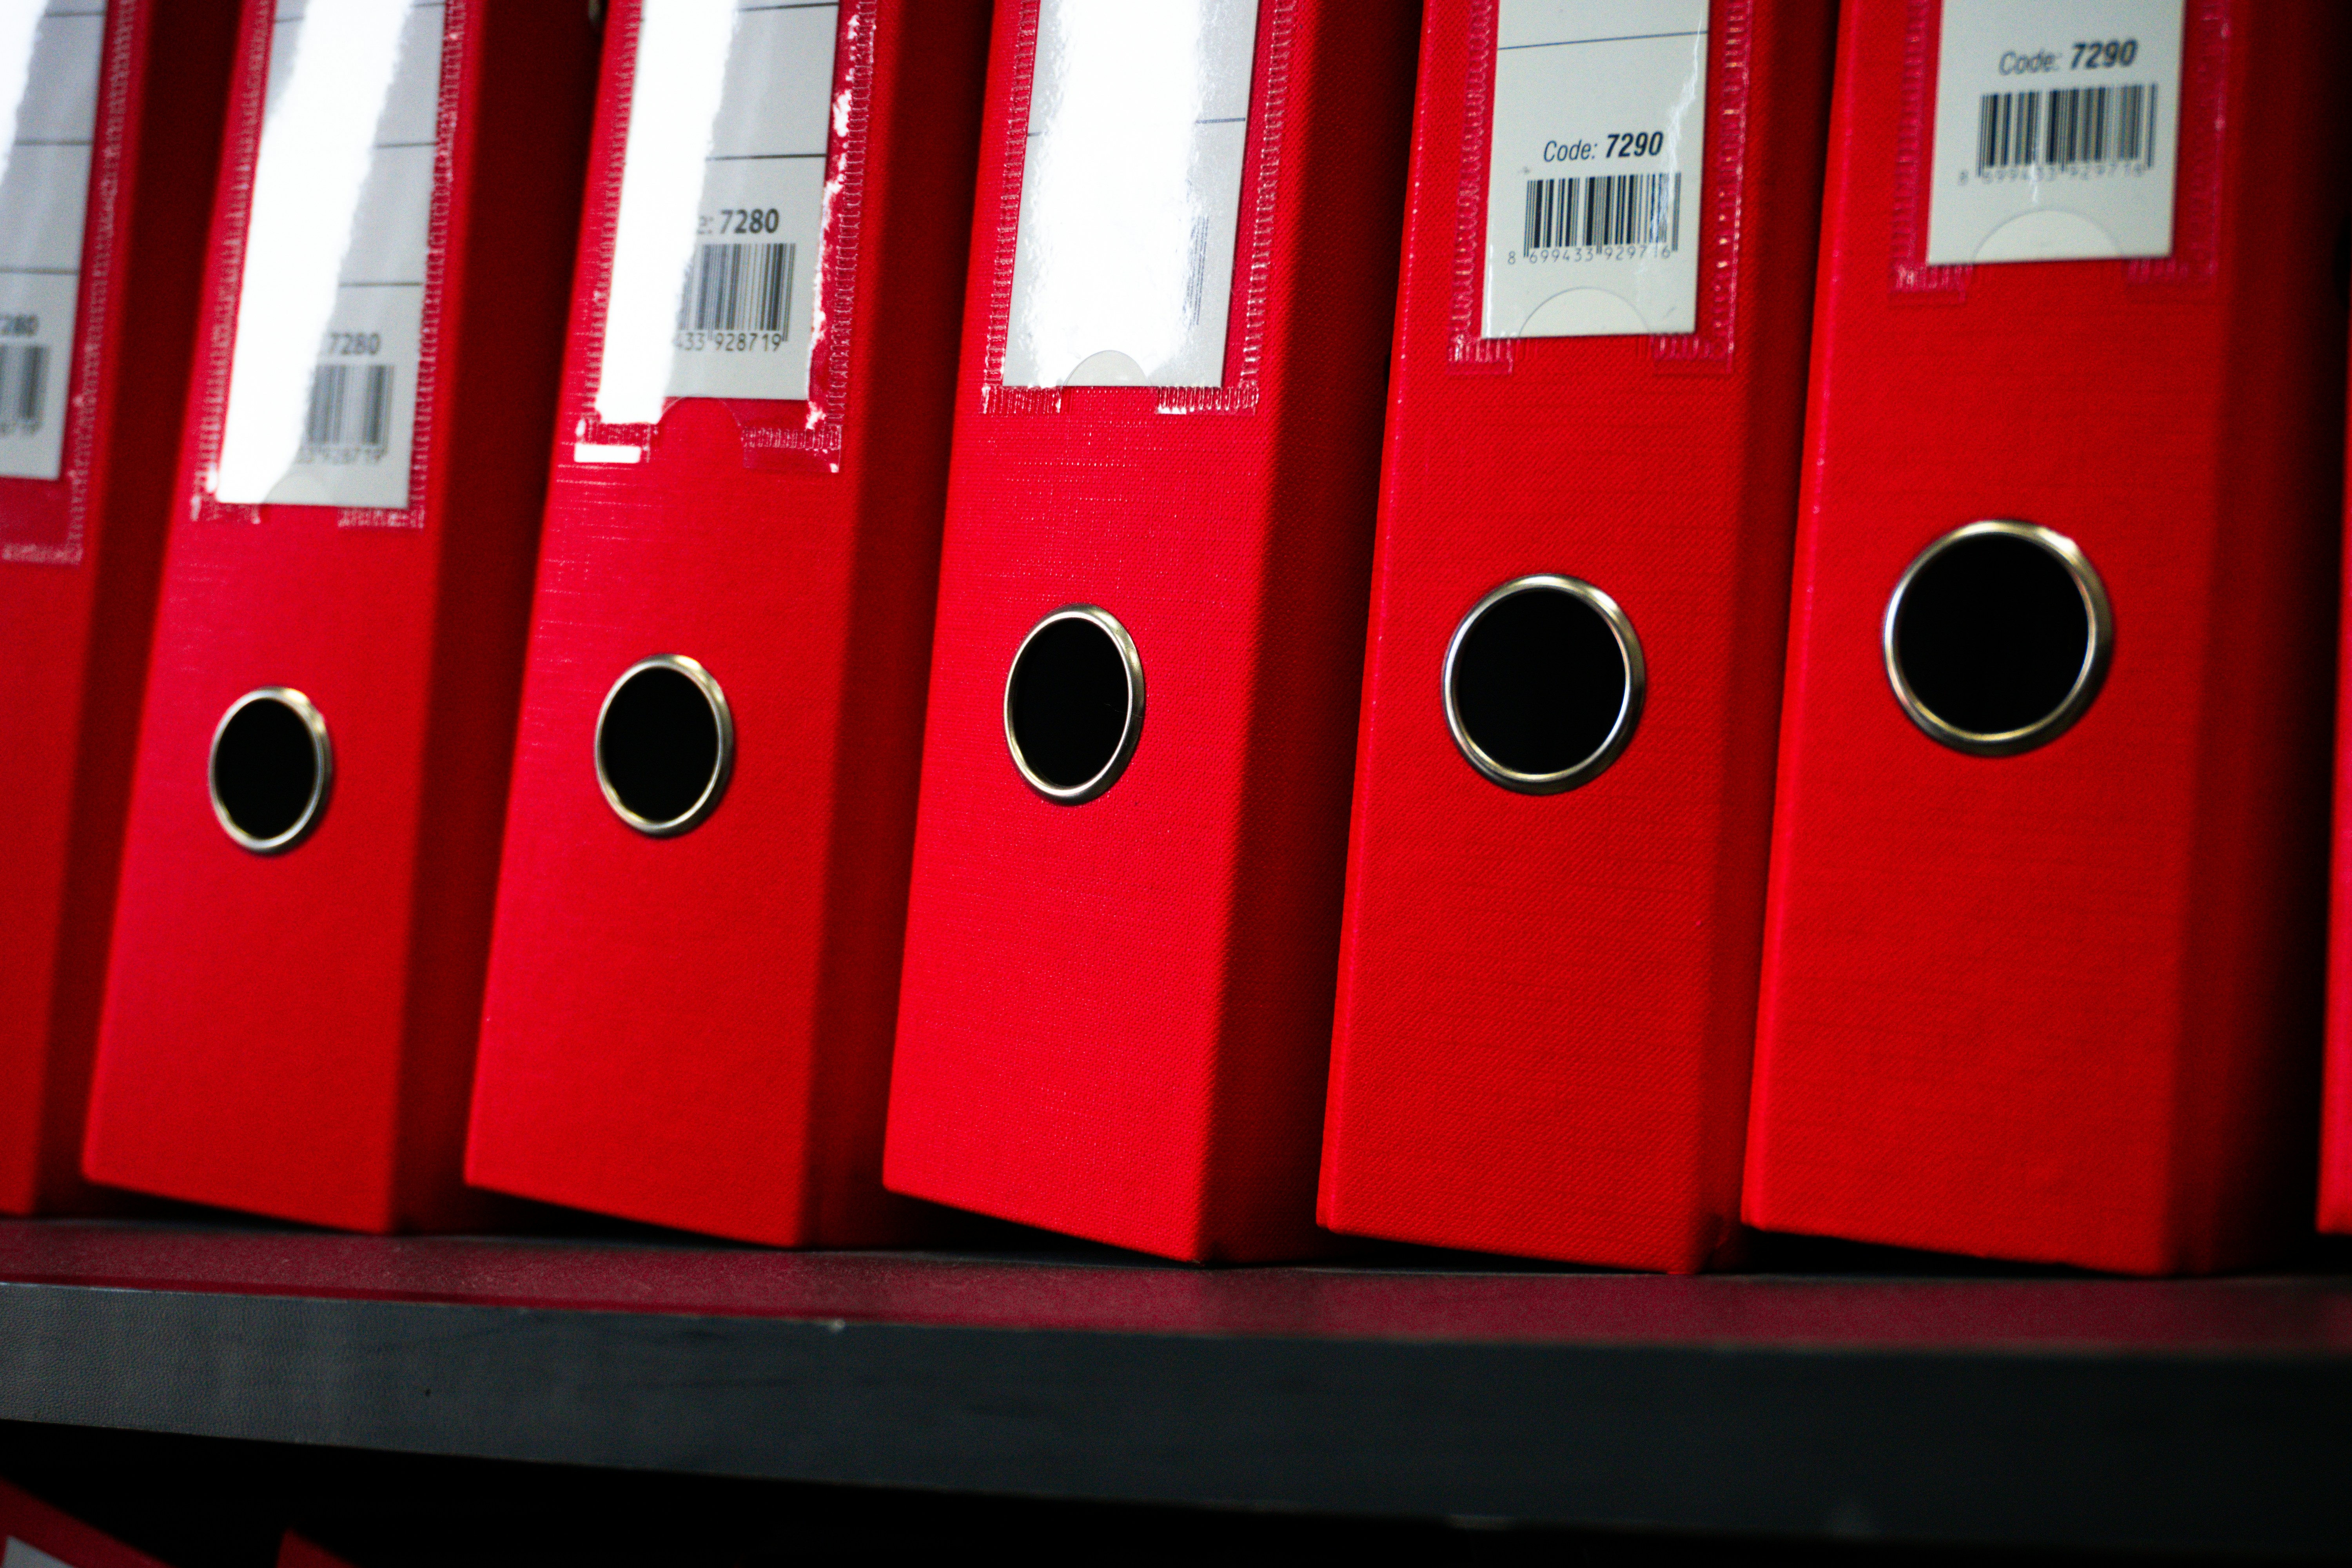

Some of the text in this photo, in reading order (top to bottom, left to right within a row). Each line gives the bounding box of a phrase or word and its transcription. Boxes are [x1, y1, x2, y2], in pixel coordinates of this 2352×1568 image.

[1999, 39, 2138, 75] Code: 7290
[1543, 131, 1664, 162] Code: 7290
[720, 208, 780, 234] 7280
[1507, 250, 1516, 265] 8
[1529, 247, 1594, 264] 699433
[0, 314, 38, 336] 280
[330, 332, 381, 356] 7280
[714, 332, 782, 352] 928719
